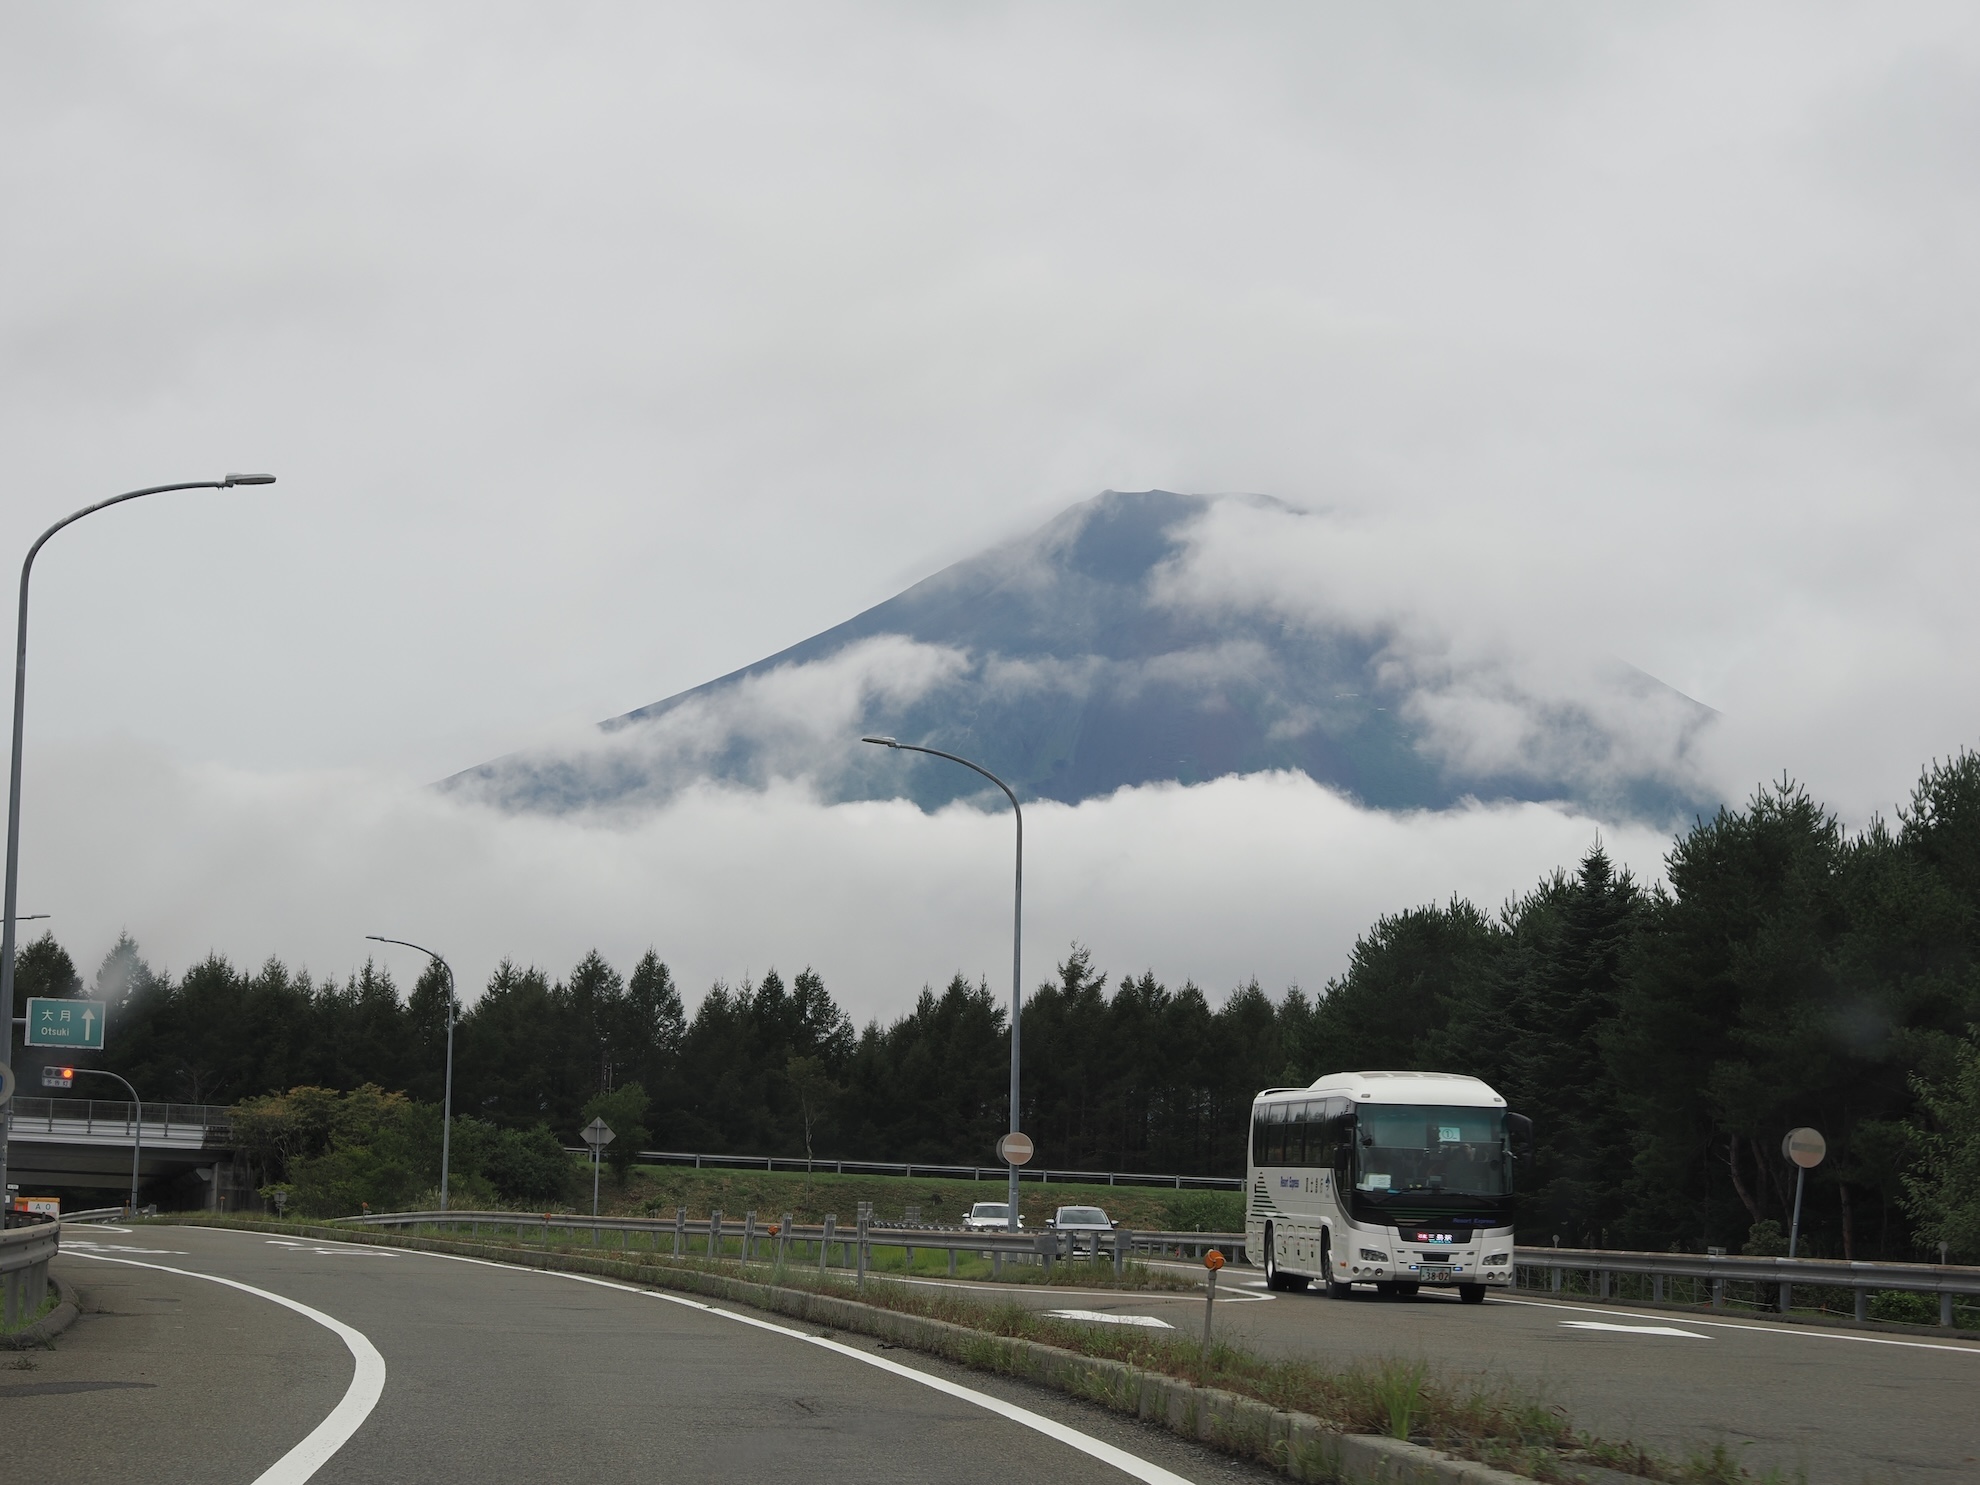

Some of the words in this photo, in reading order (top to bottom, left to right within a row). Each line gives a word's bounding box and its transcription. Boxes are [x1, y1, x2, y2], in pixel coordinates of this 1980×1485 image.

[42, 1009, 71, 1022] 大月
[41, 1027, 70, 1036] Otsuki
[1426, 1272, 1449, 1280] 38-02
